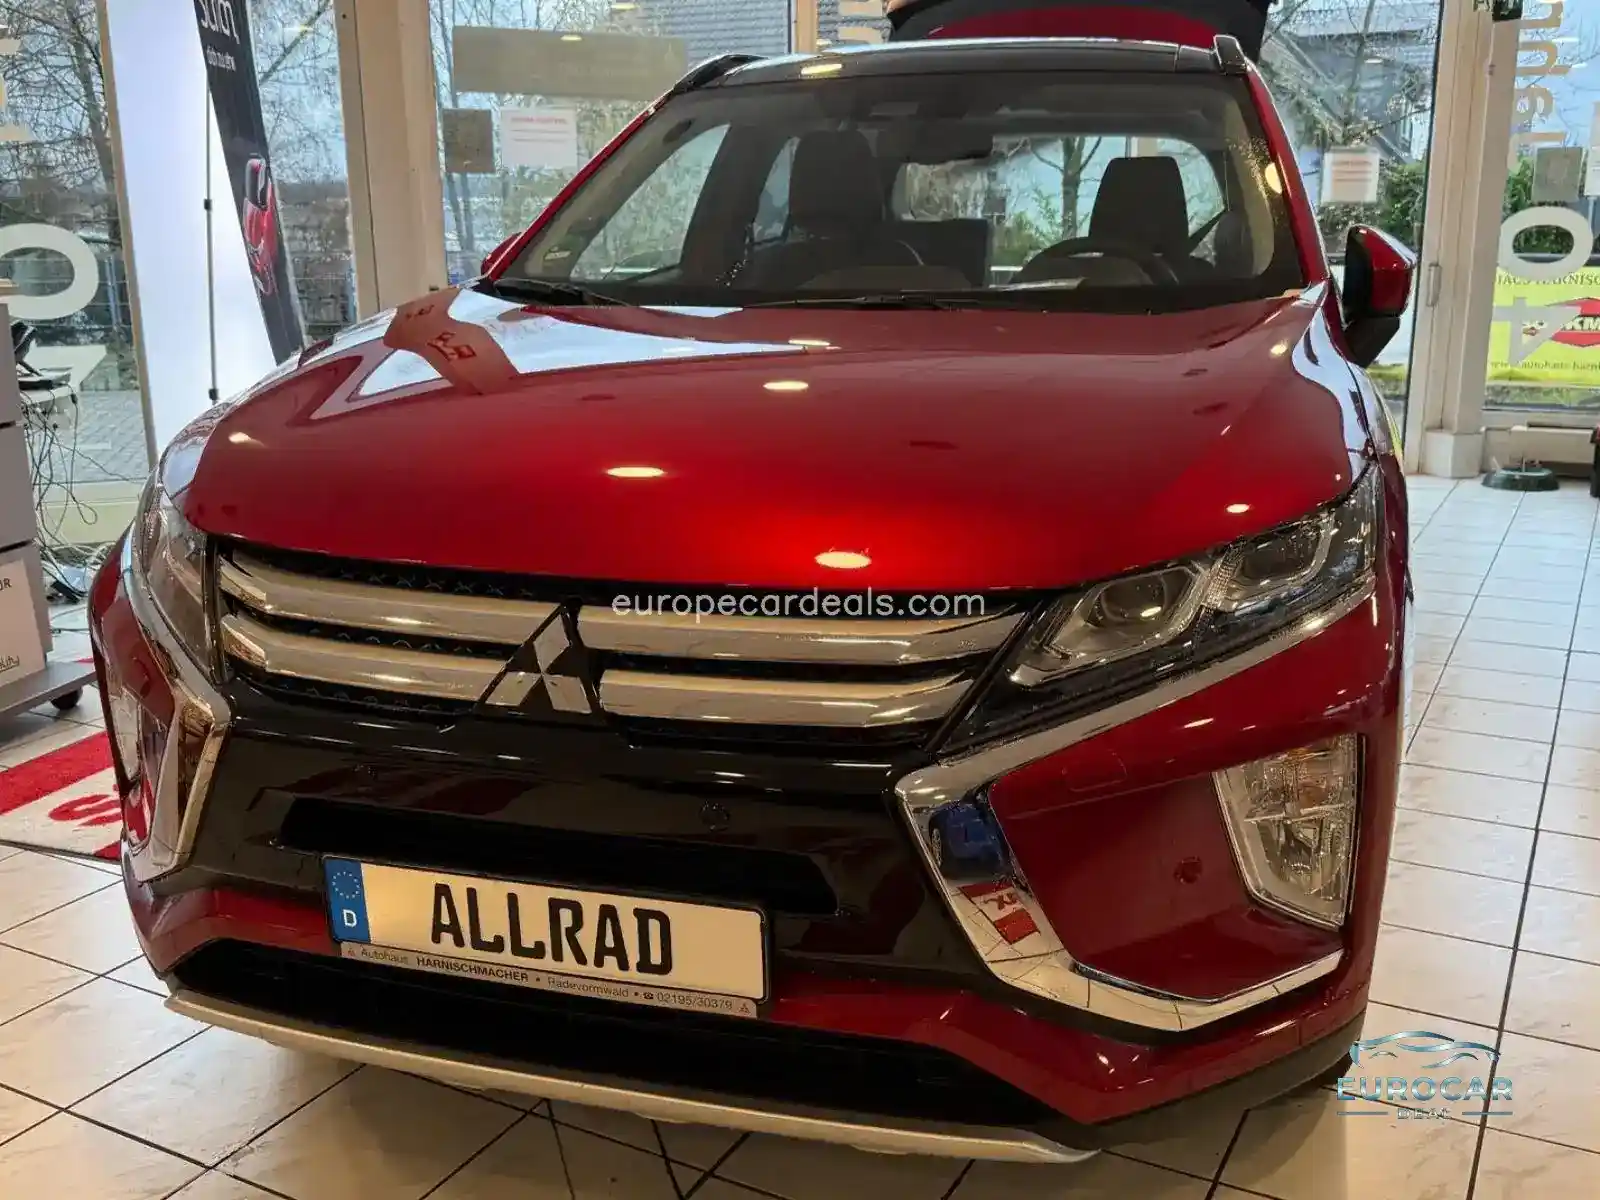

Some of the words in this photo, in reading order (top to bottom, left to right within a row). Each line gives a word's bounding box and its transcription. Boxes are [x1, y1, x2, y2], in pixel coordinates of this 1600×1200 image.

[342, 908, 358, 927] D
[431, 882, 672, 976] ALLRAD
[361, 946, 409, 965] Autohaus
[416, 956, 529, 982] HARNISCHMACHER
[547, 977, 629, 998] Radevormwald
